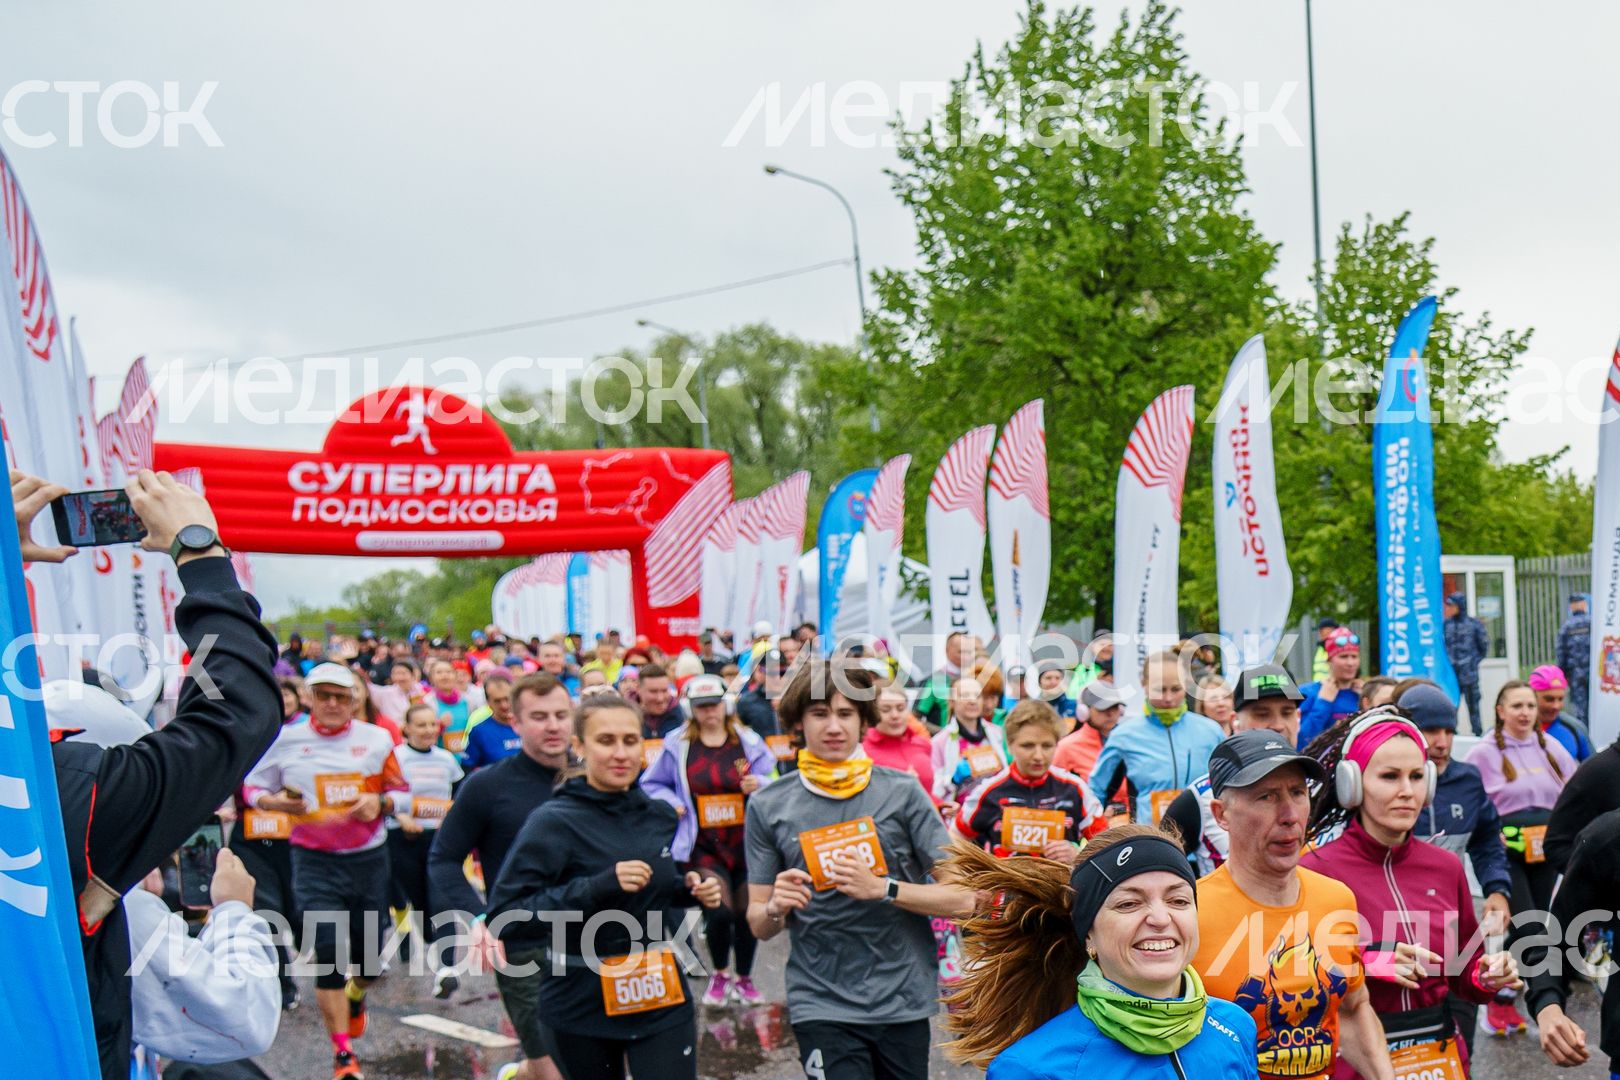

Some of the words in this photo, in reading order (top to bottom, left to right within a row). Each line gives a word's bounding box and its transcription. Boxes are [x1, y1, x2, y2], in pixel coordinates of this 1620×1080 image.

[287, 461, 557, 495] СУПЕРЛИГА
[291, 496, 559, 527] ПОДМОСКОВЬЯ
[1012, 825, 1049, 846] 5221
[615, 971, 667, 1004] 5066
[1207, 1015, 1235, 1038] CRAFT
[1278, 1026, 1316, 1047] OCR
